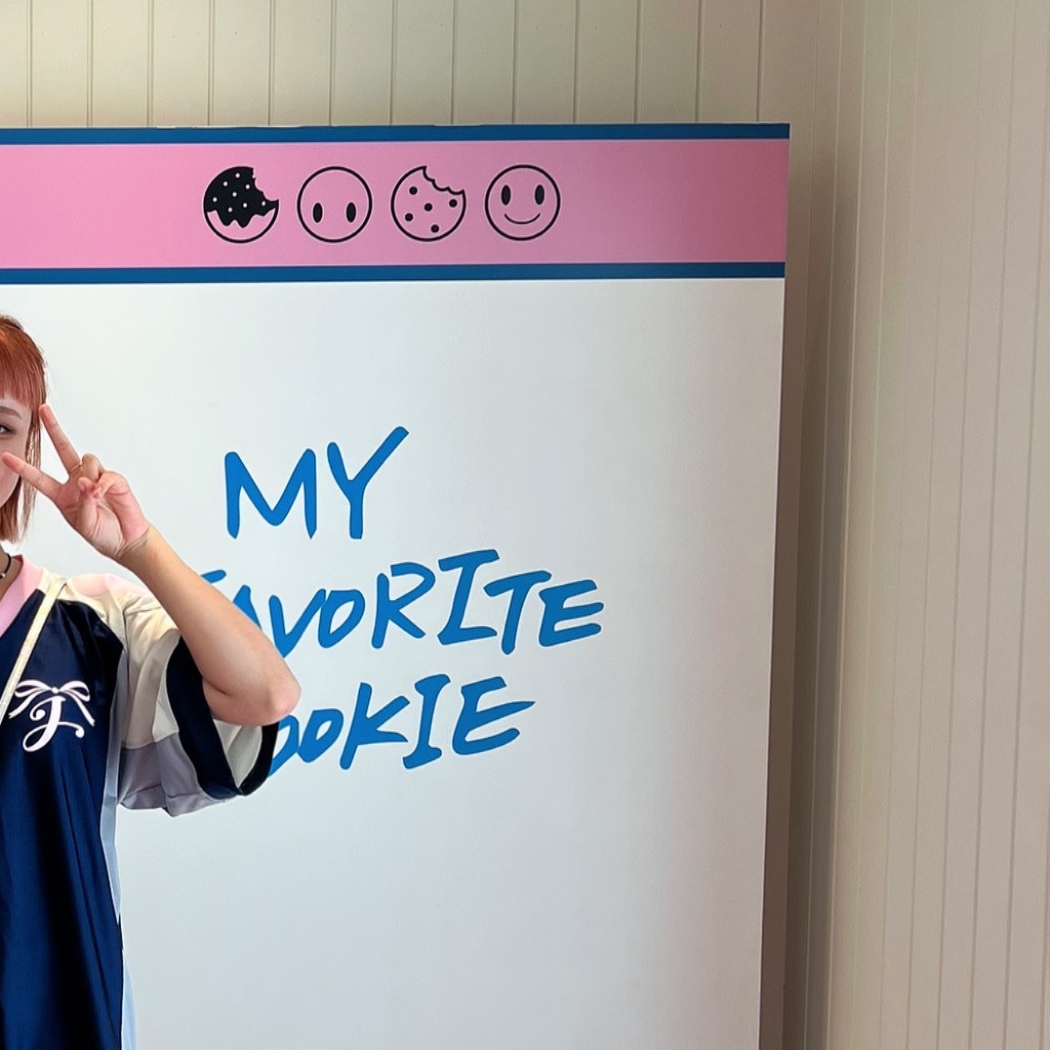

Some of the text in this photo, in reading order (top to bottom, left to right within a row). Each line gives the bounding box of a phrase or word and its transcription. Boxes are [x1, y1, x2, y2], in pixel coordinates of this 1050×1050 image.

[224, 426, 409, 539] MY
[200, 549, 604, 658] VORITE
[267, 674, 536, 778] OOKIE
